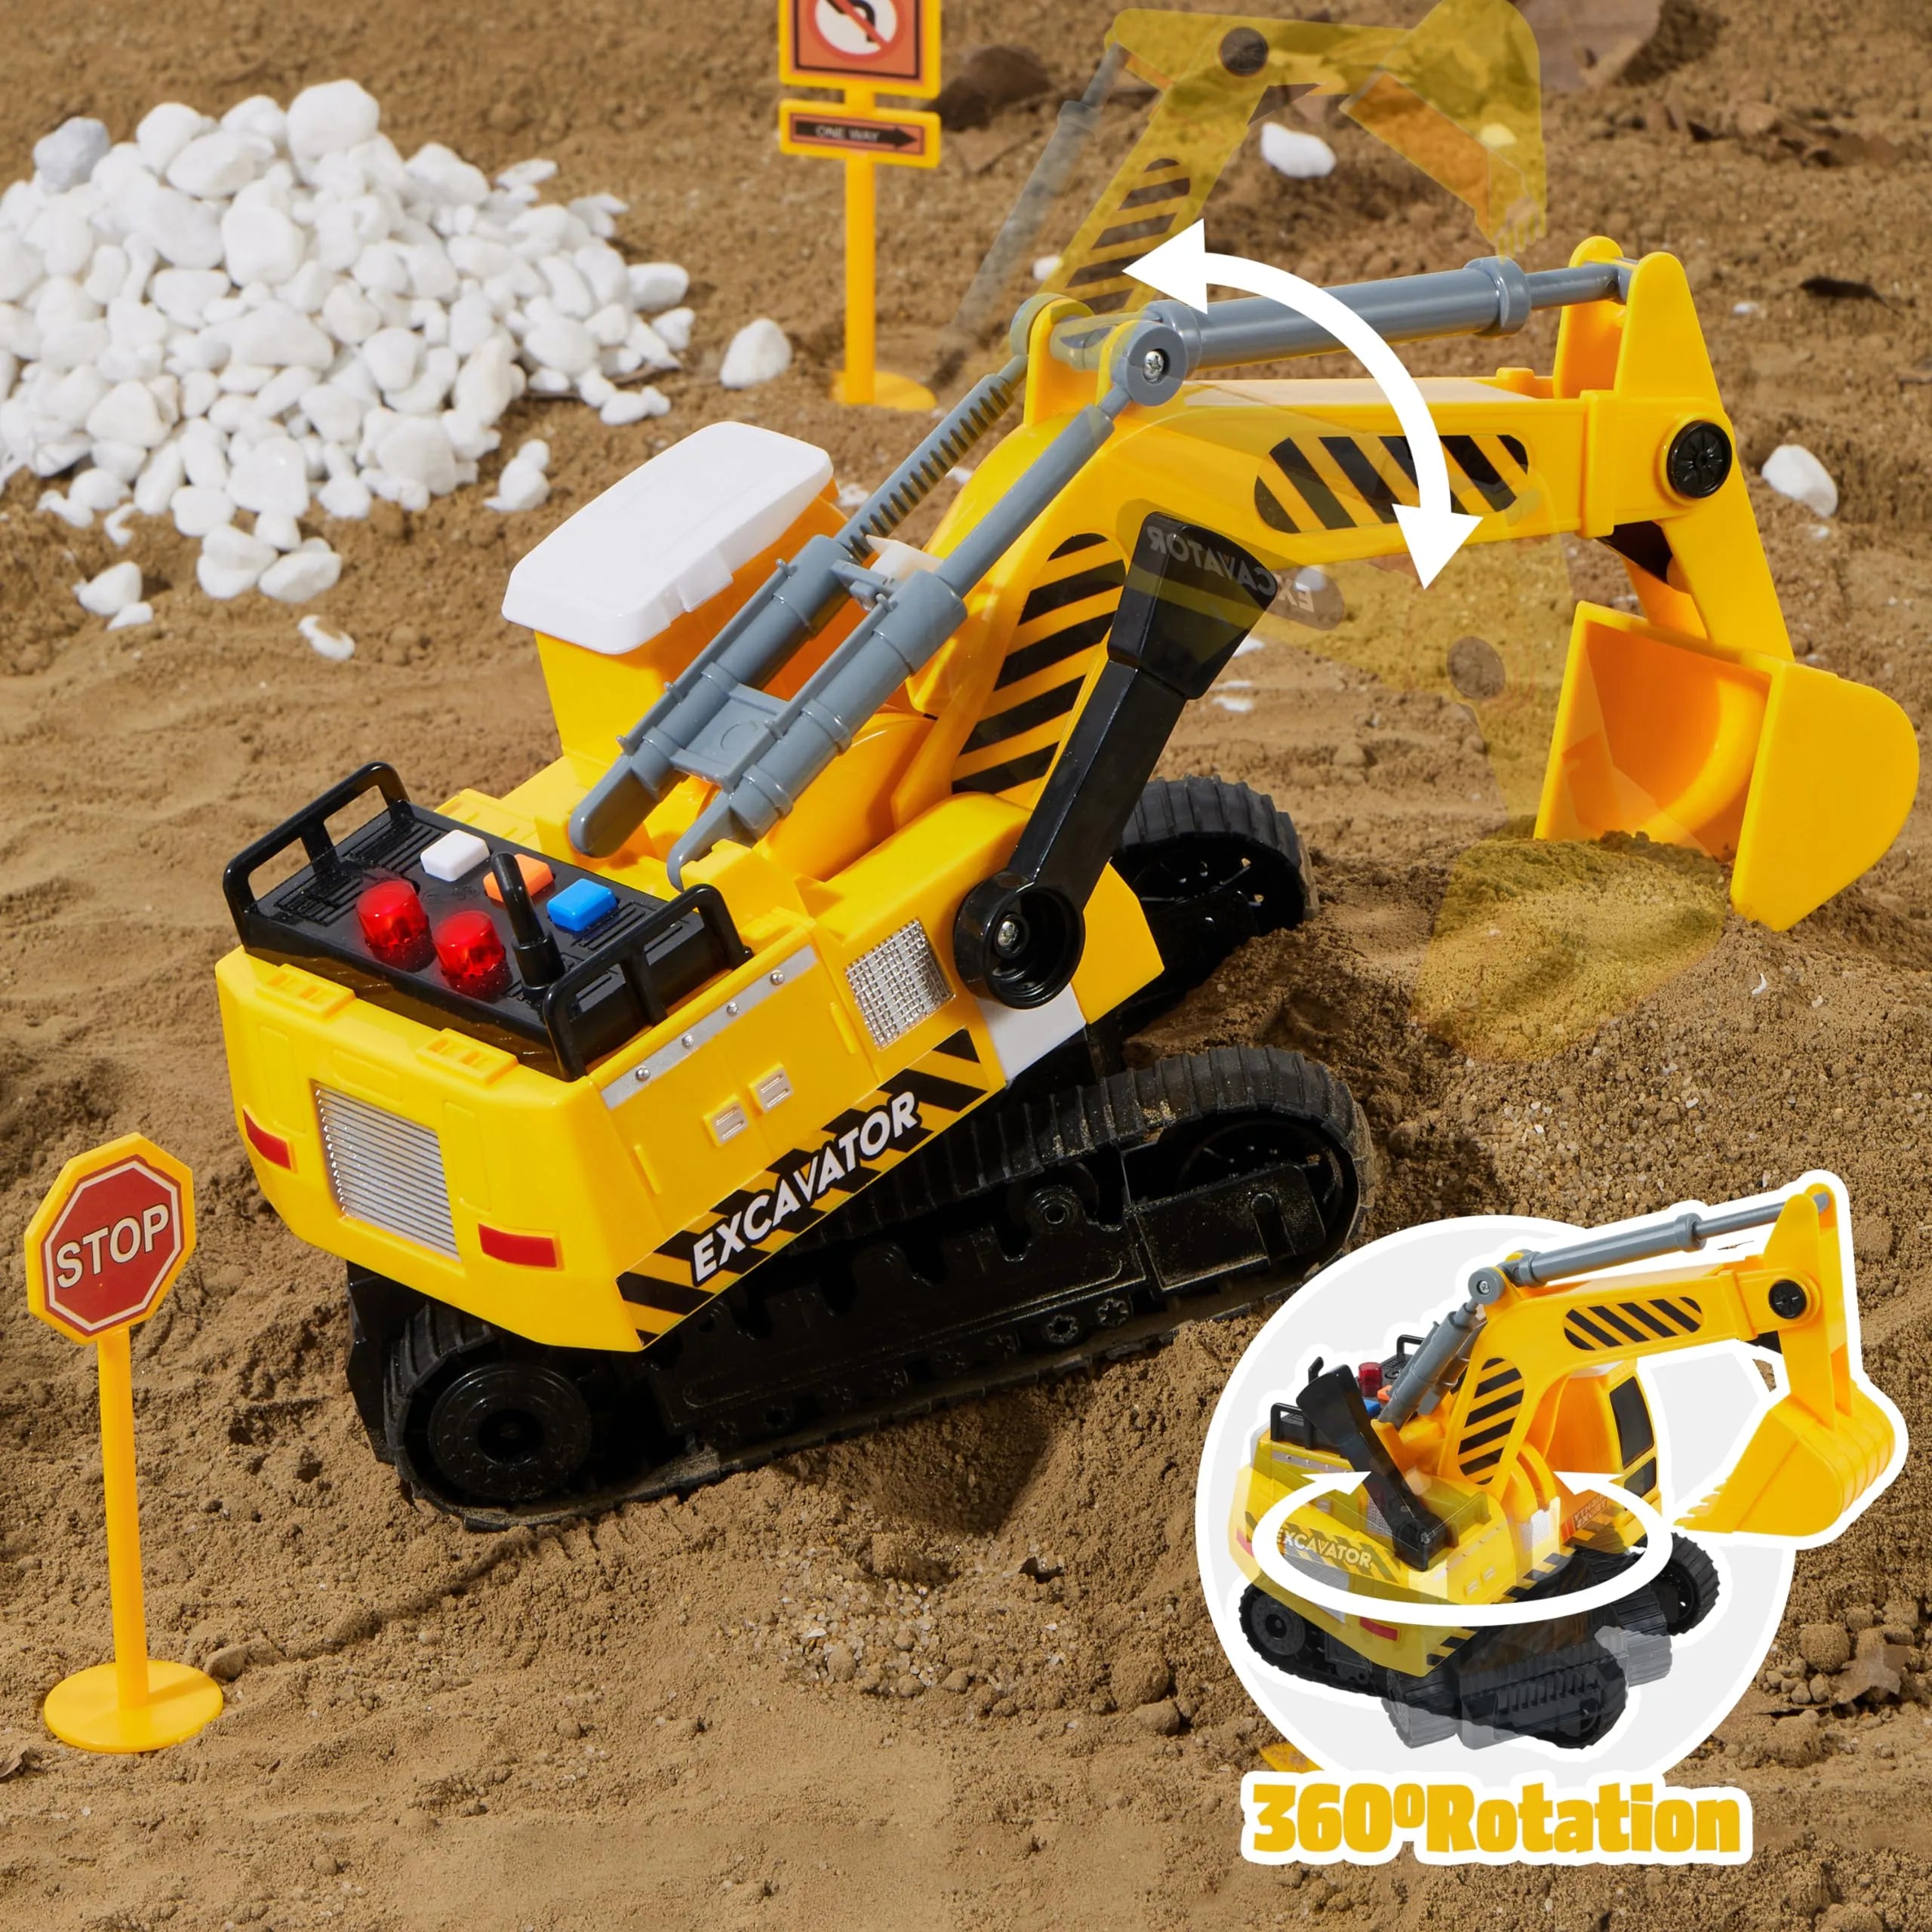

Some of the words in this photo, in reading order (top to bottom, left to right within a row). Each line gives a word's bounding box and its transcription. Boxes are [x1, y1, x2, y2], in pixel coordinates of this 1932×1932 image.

[815, 125, 846, 140] ONE
[848, 128, 880, 142] WAY
[692, 1091, 918, 1282] EXCAVATOR
[56, 1203, 170, 1288] STOP
